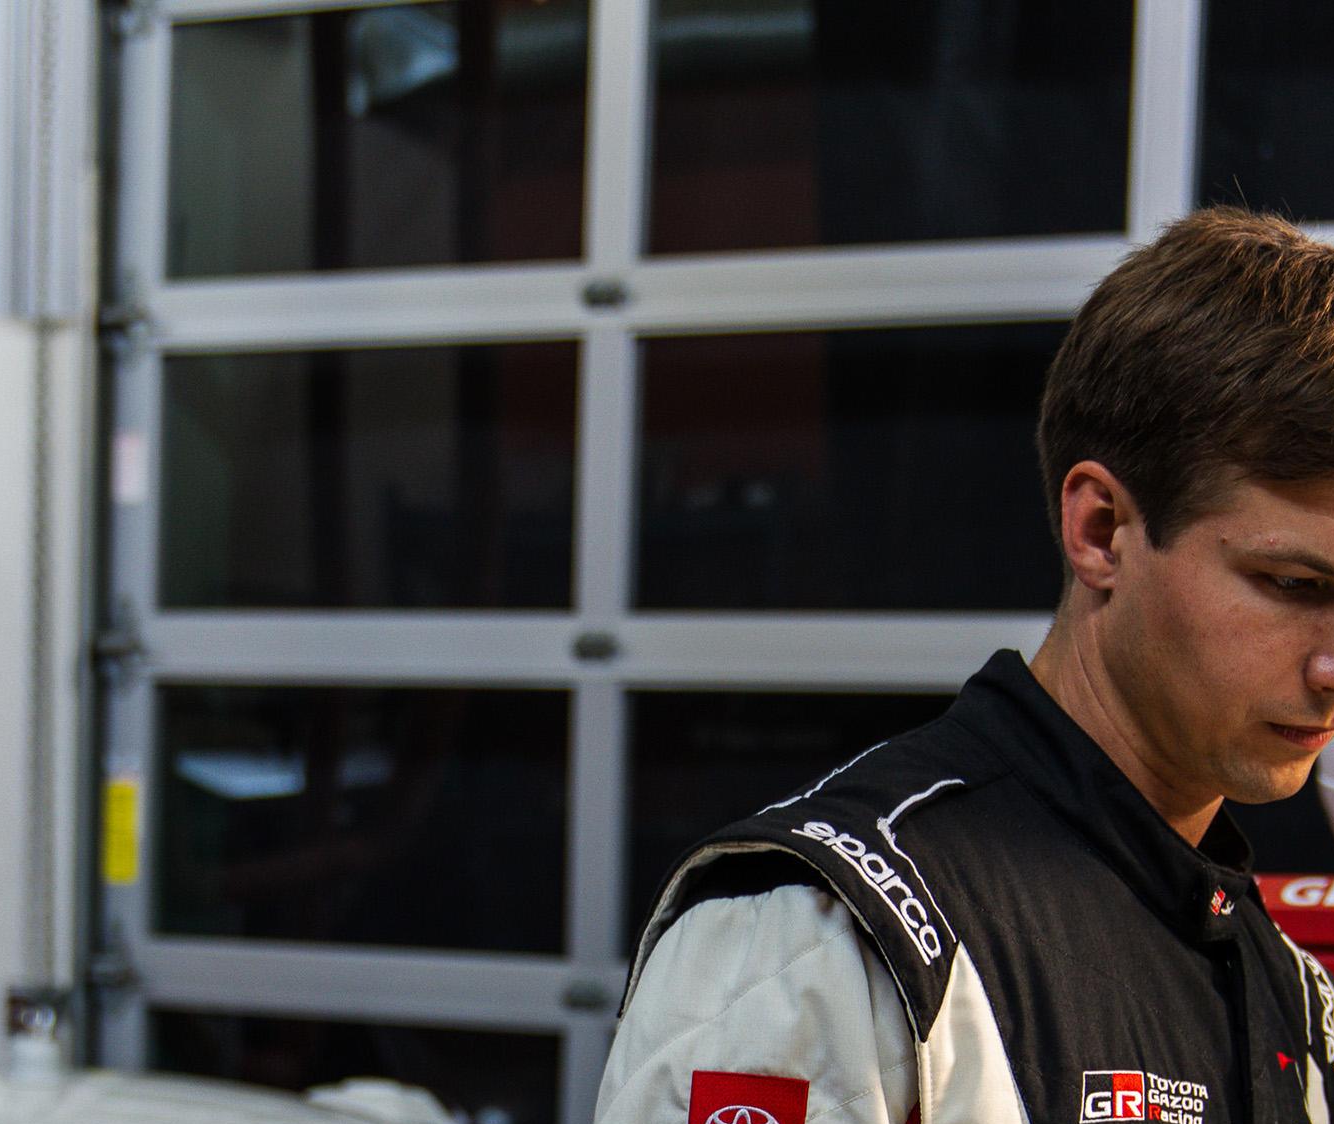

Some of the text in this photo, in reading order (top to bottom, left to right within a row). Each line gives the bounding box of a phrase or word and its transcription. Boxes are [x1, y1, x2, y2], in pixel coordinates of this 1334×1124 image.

[799, 821, 942, 963] sparco
[1147, 1072, 1208, 1099] TOYOTA
[1085, 1090, 1143, 1119] GR
[1148, 1088, 1204, 1113] GAZOO
